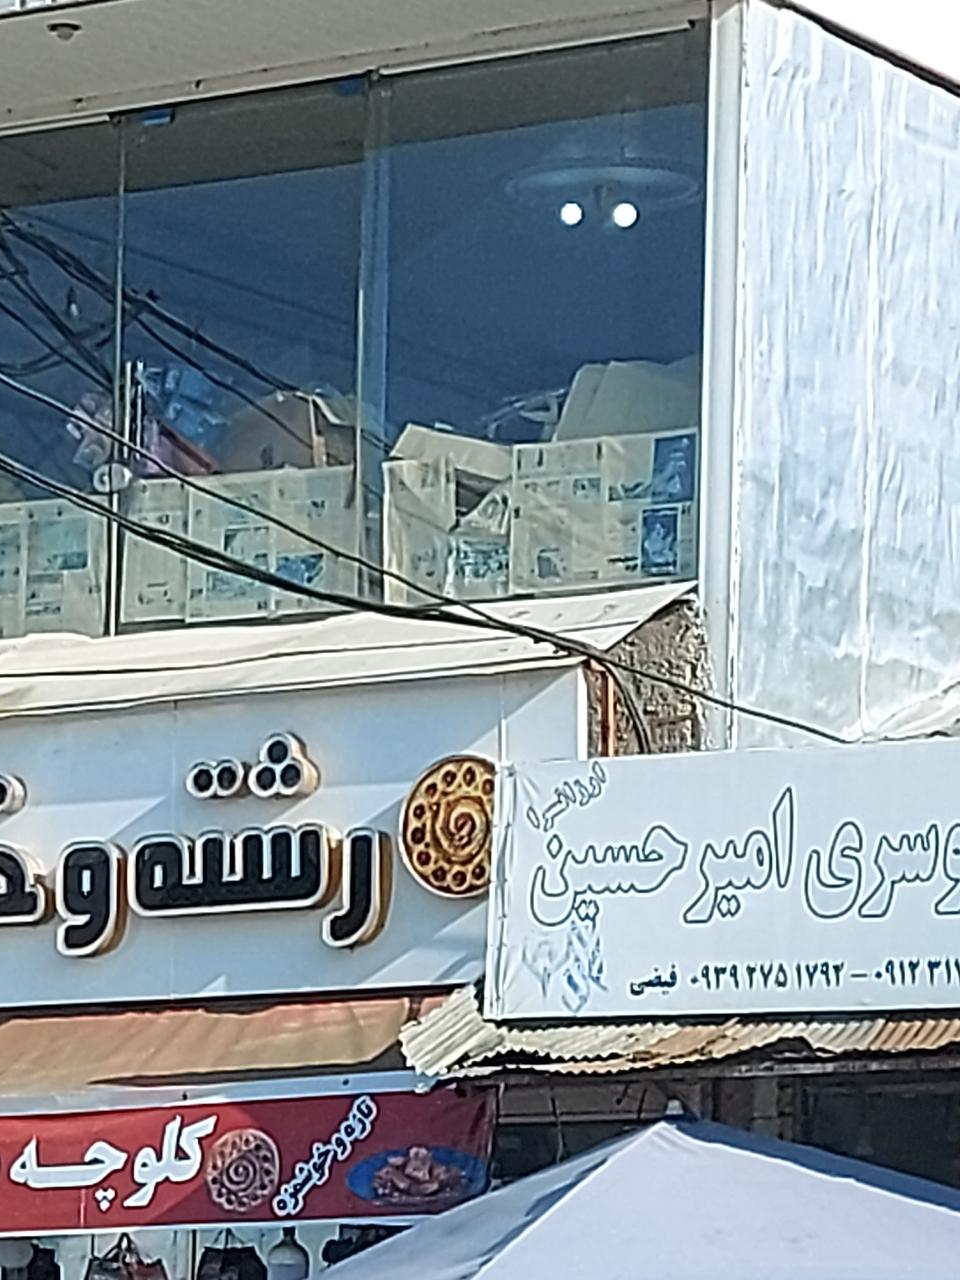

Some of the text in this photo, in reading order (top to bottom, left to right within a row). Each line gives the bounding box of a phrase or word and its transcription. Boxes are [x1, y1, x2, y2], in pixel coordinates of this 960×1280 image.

[55, 838, 128, 957] و
[128, 730, 398, 950] رشته
[9, 1114, 218, 1211] کلوچه
